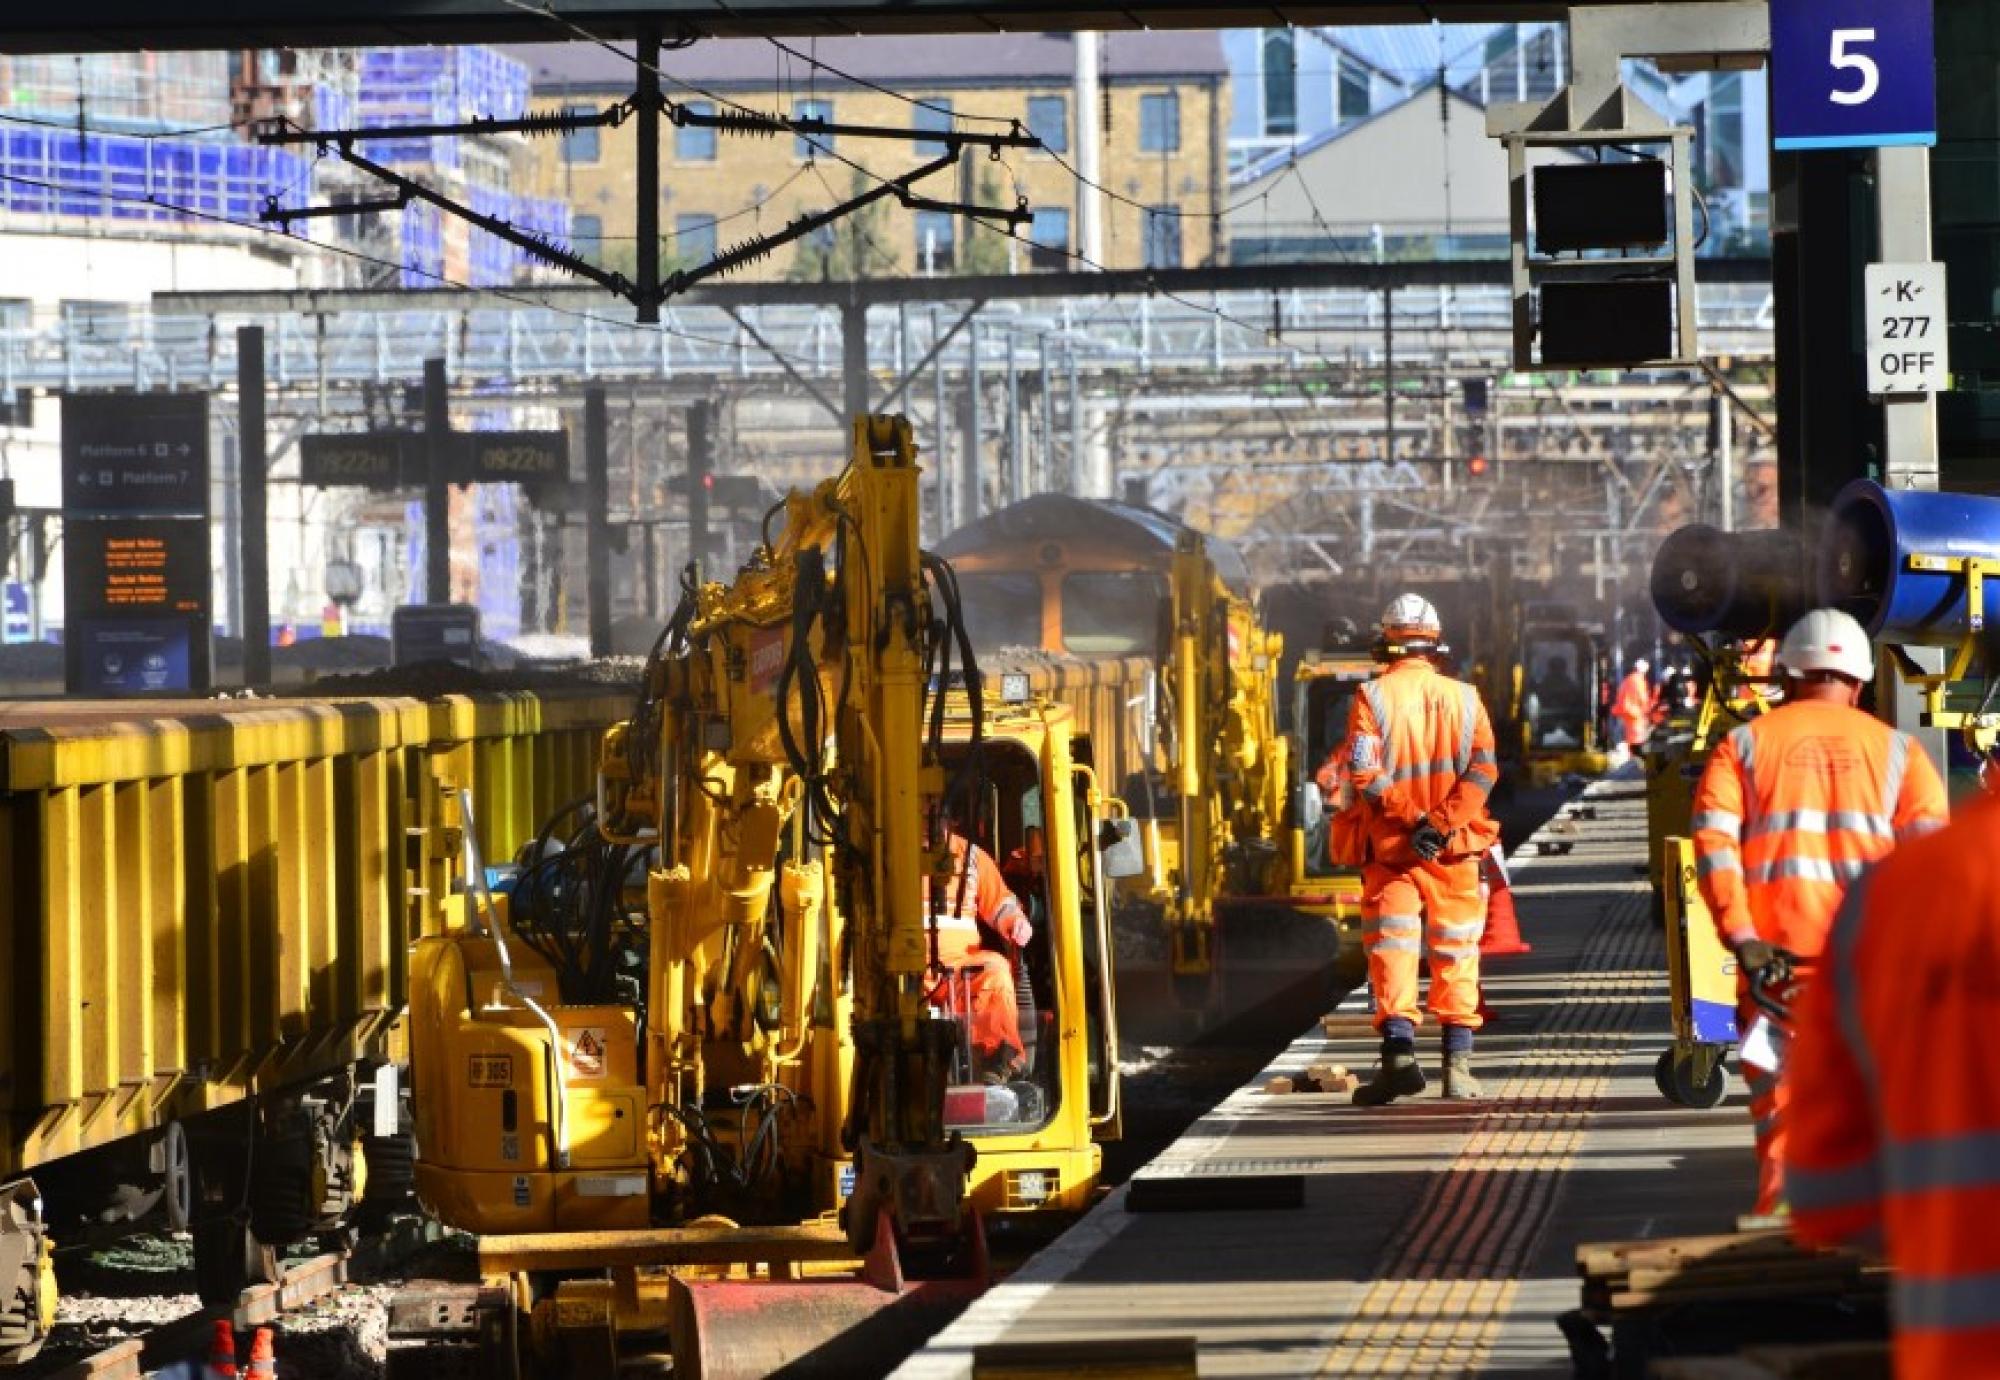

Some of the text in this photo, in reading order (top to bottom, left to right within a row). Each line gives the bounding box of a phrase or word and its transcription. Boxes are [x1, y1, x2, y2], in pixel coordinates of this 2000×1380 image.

[1829, 27, 1880, 106] 5
[1896, 280, 1914, 302] K
[1882, 315, 1930, 339] 277
[1880, 351, 1935, 376] OFF
[80, 442, 136, 457] Platform
[122, 470, 178, 485] Platform
